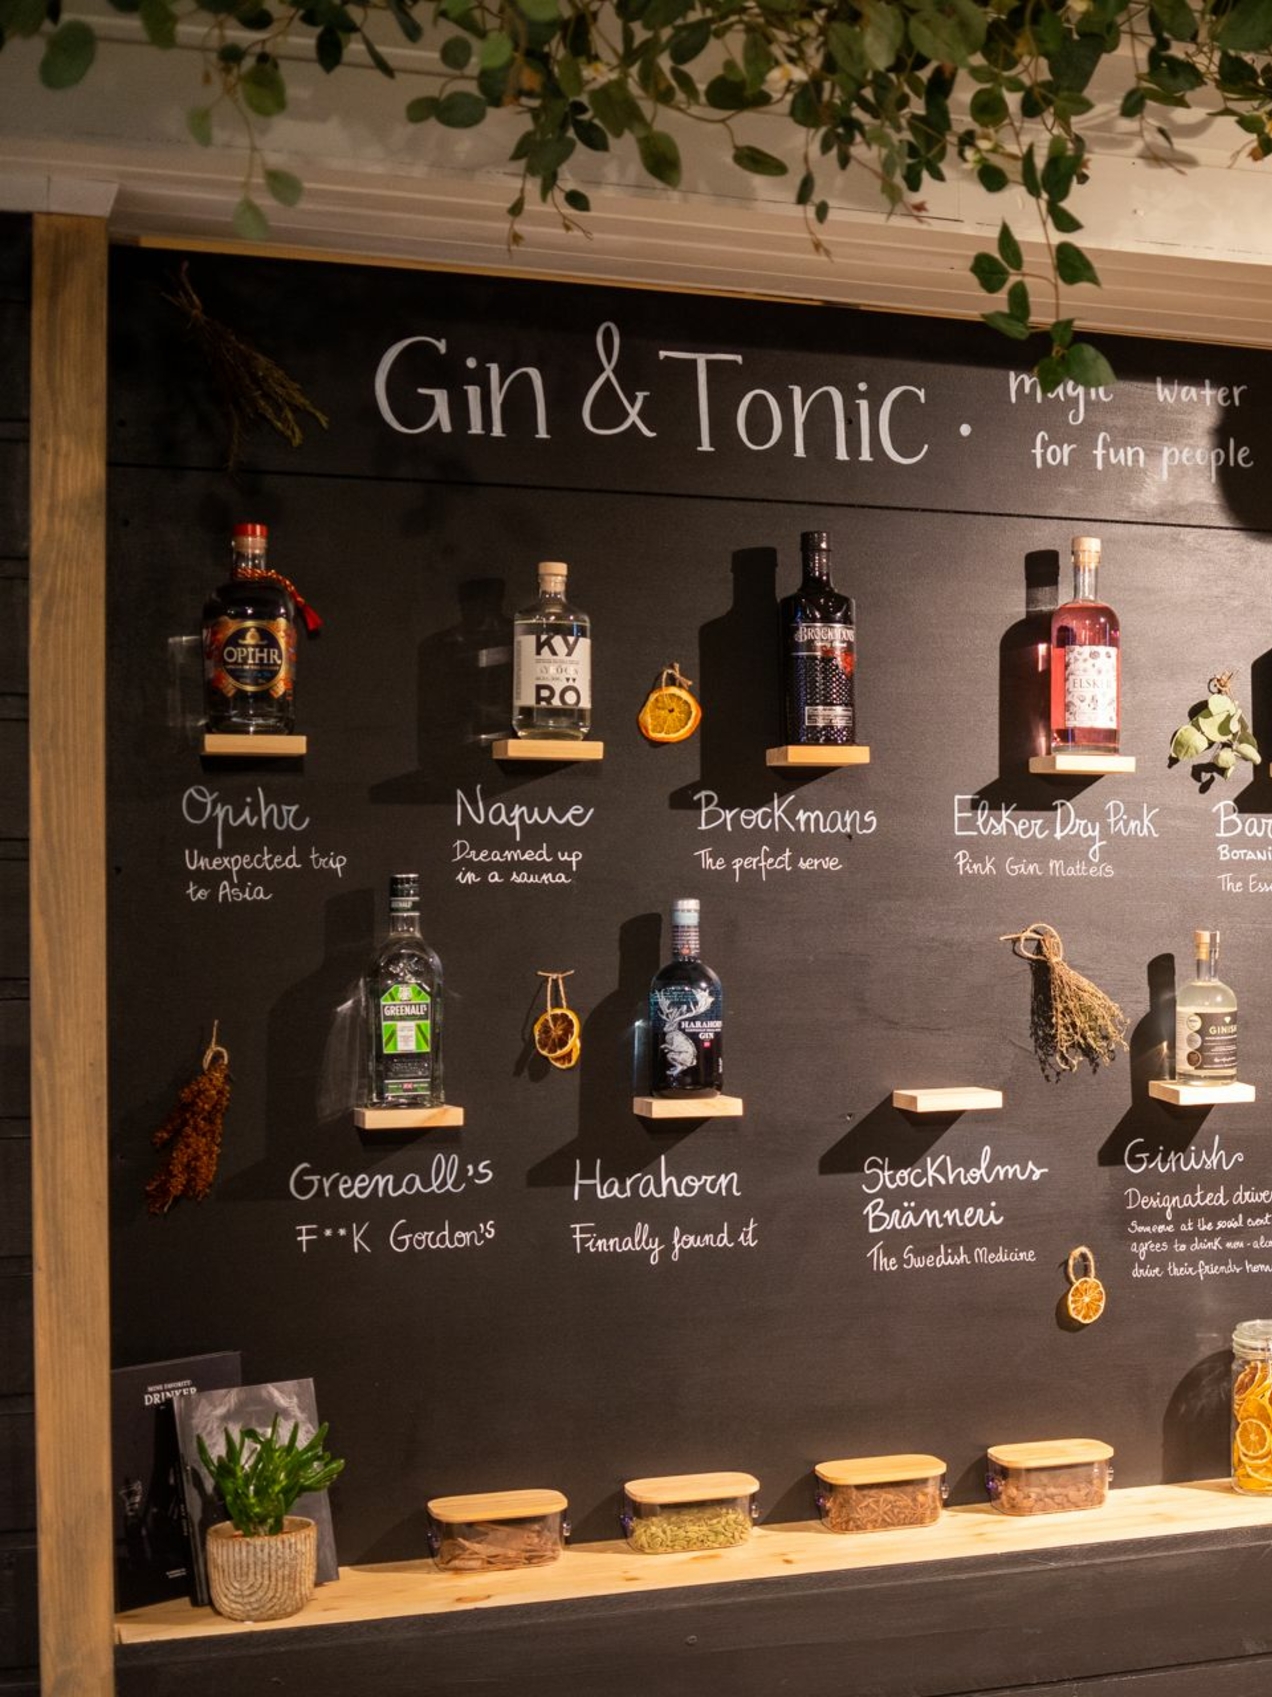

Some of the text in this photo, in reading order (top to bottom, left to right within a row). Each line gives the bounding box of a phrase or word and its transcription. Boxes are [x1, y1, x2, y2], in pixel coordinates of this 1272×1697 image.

[374, 321, 929, 465] Gin & Tonic
[1031, 431, 1254, 483] for fun people
[223, 646, 282, 665] OPIHR
[535, 634, 580, 657] KY
[182, 785, 309, 849] Opihr
[455, 785, 595, 842] Napue
[1052, 799, 1107, 862] Dry
[1105, 800, 1160, 838] Pink
[184, 847, 347, 883] Unexpected trip
[451, 839, 583, 871] Dreamed up
[693, 846, 843, 883] The perfect serve
[953, 850, 1114, 879] Pink Gin Matters
[186, 880, 272, 902] to Asia
[455, 867, 572, 885] in a sauna
[1217, 872, 1243, 893] The
[861, 1145, 1049, 1193] Stockholms
[1123, 1134, 1245, 1174] Ginish
[289, 1153, 495, 1200] Greenall's
[573, 1154, 742, 1201] Harahorn
[862, 1198, 1004, 1233] Bränneri
[1123, 1184, 1230, 1220] Designated
[389, 1217, 496, 1253] Gordon's
[671, 1223, 735, 1261] found
[737, 1217, 759, 1249] it
[1127, 1220, 1175, 1233] Someone
[1180, 1219, 1194, 1231] at
[1197, 1217, 1214, 1231] the
[1215, 1213, 1244, 1230] social
[866, 1241, 1037, 1271] The Swedish Medicine
[1130, 1241, 1168, 1261] agrees
[1173, 1238, 1187, 1252] to
[1189, 1236, 1223, 1251] drink
[1132, 1262, 1164, 1278] drive
[1167, 1261, 1199, 1277] their
[1197, 1258, 1242, 1280] friends
